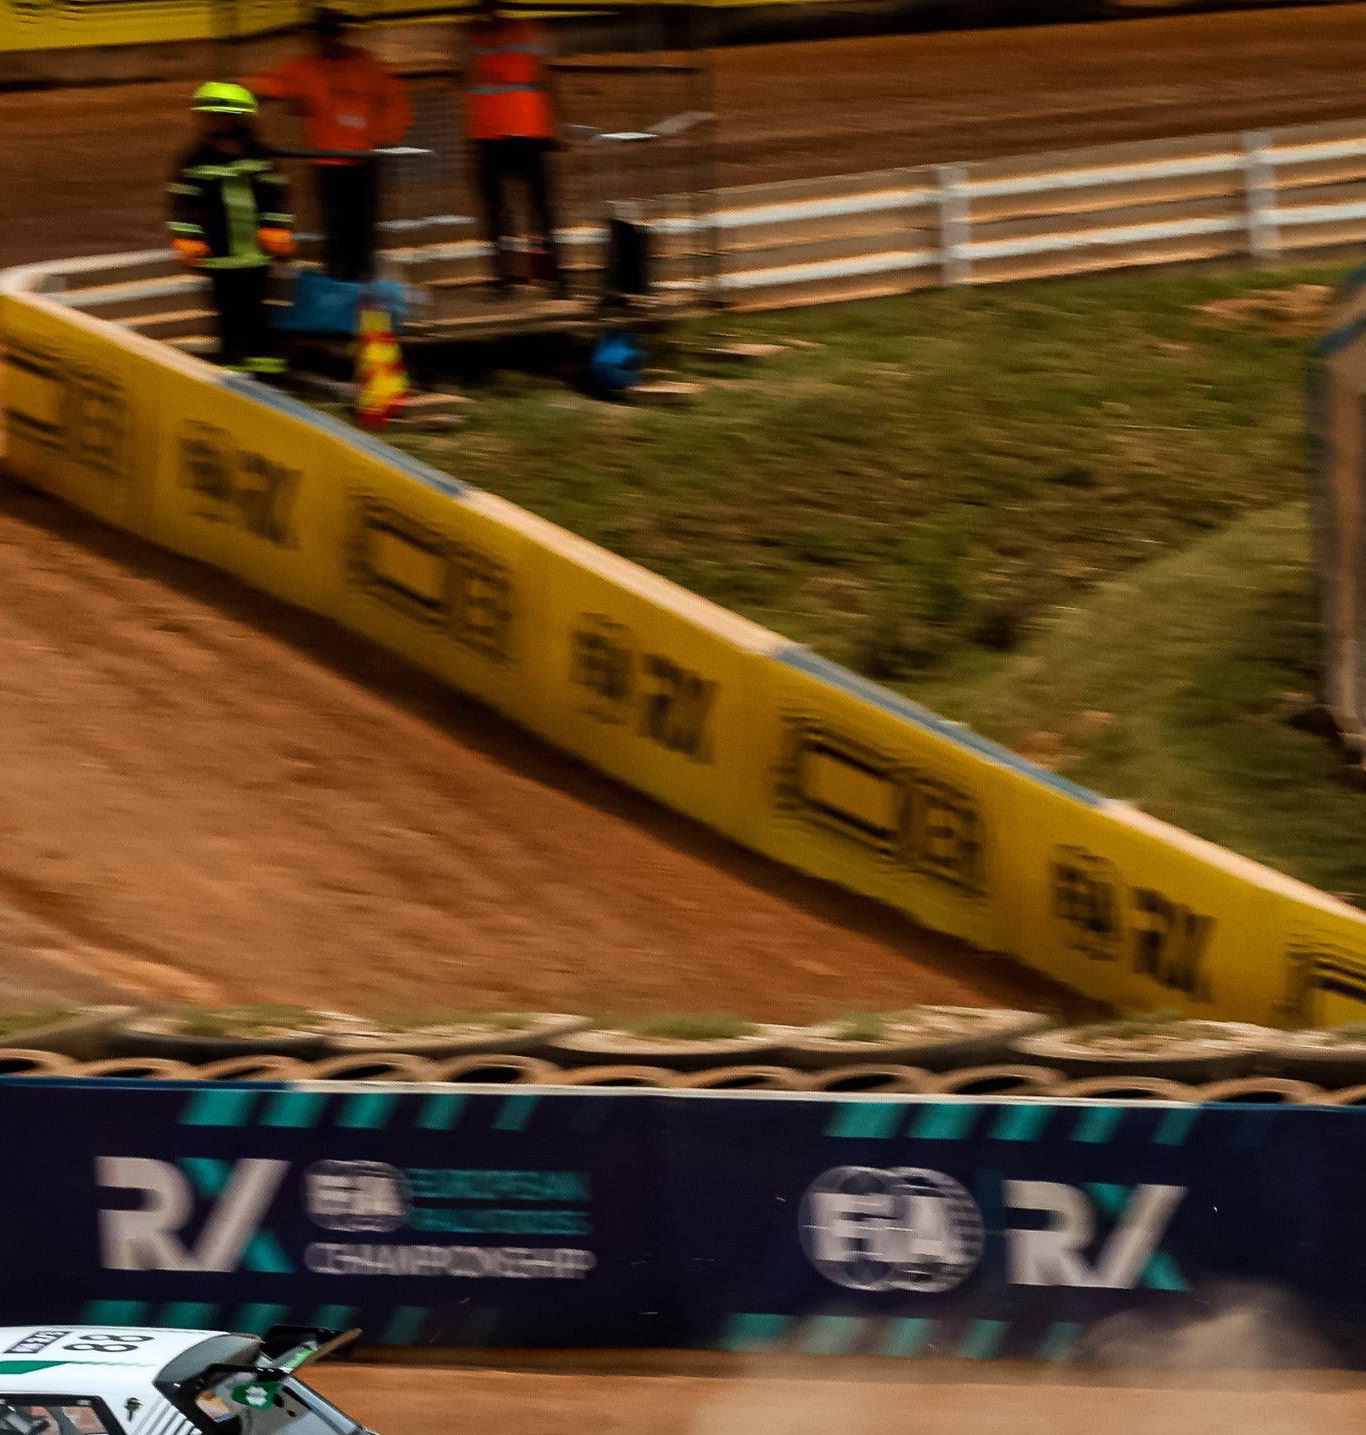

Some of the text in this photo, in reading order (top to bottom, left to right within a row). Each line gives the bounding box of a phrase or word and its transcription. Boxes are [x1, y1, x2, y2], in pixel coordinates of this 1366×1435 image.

[93, 1155, 297, 1273] RX
[813, 1178, 1190, 1291] FIA RX
